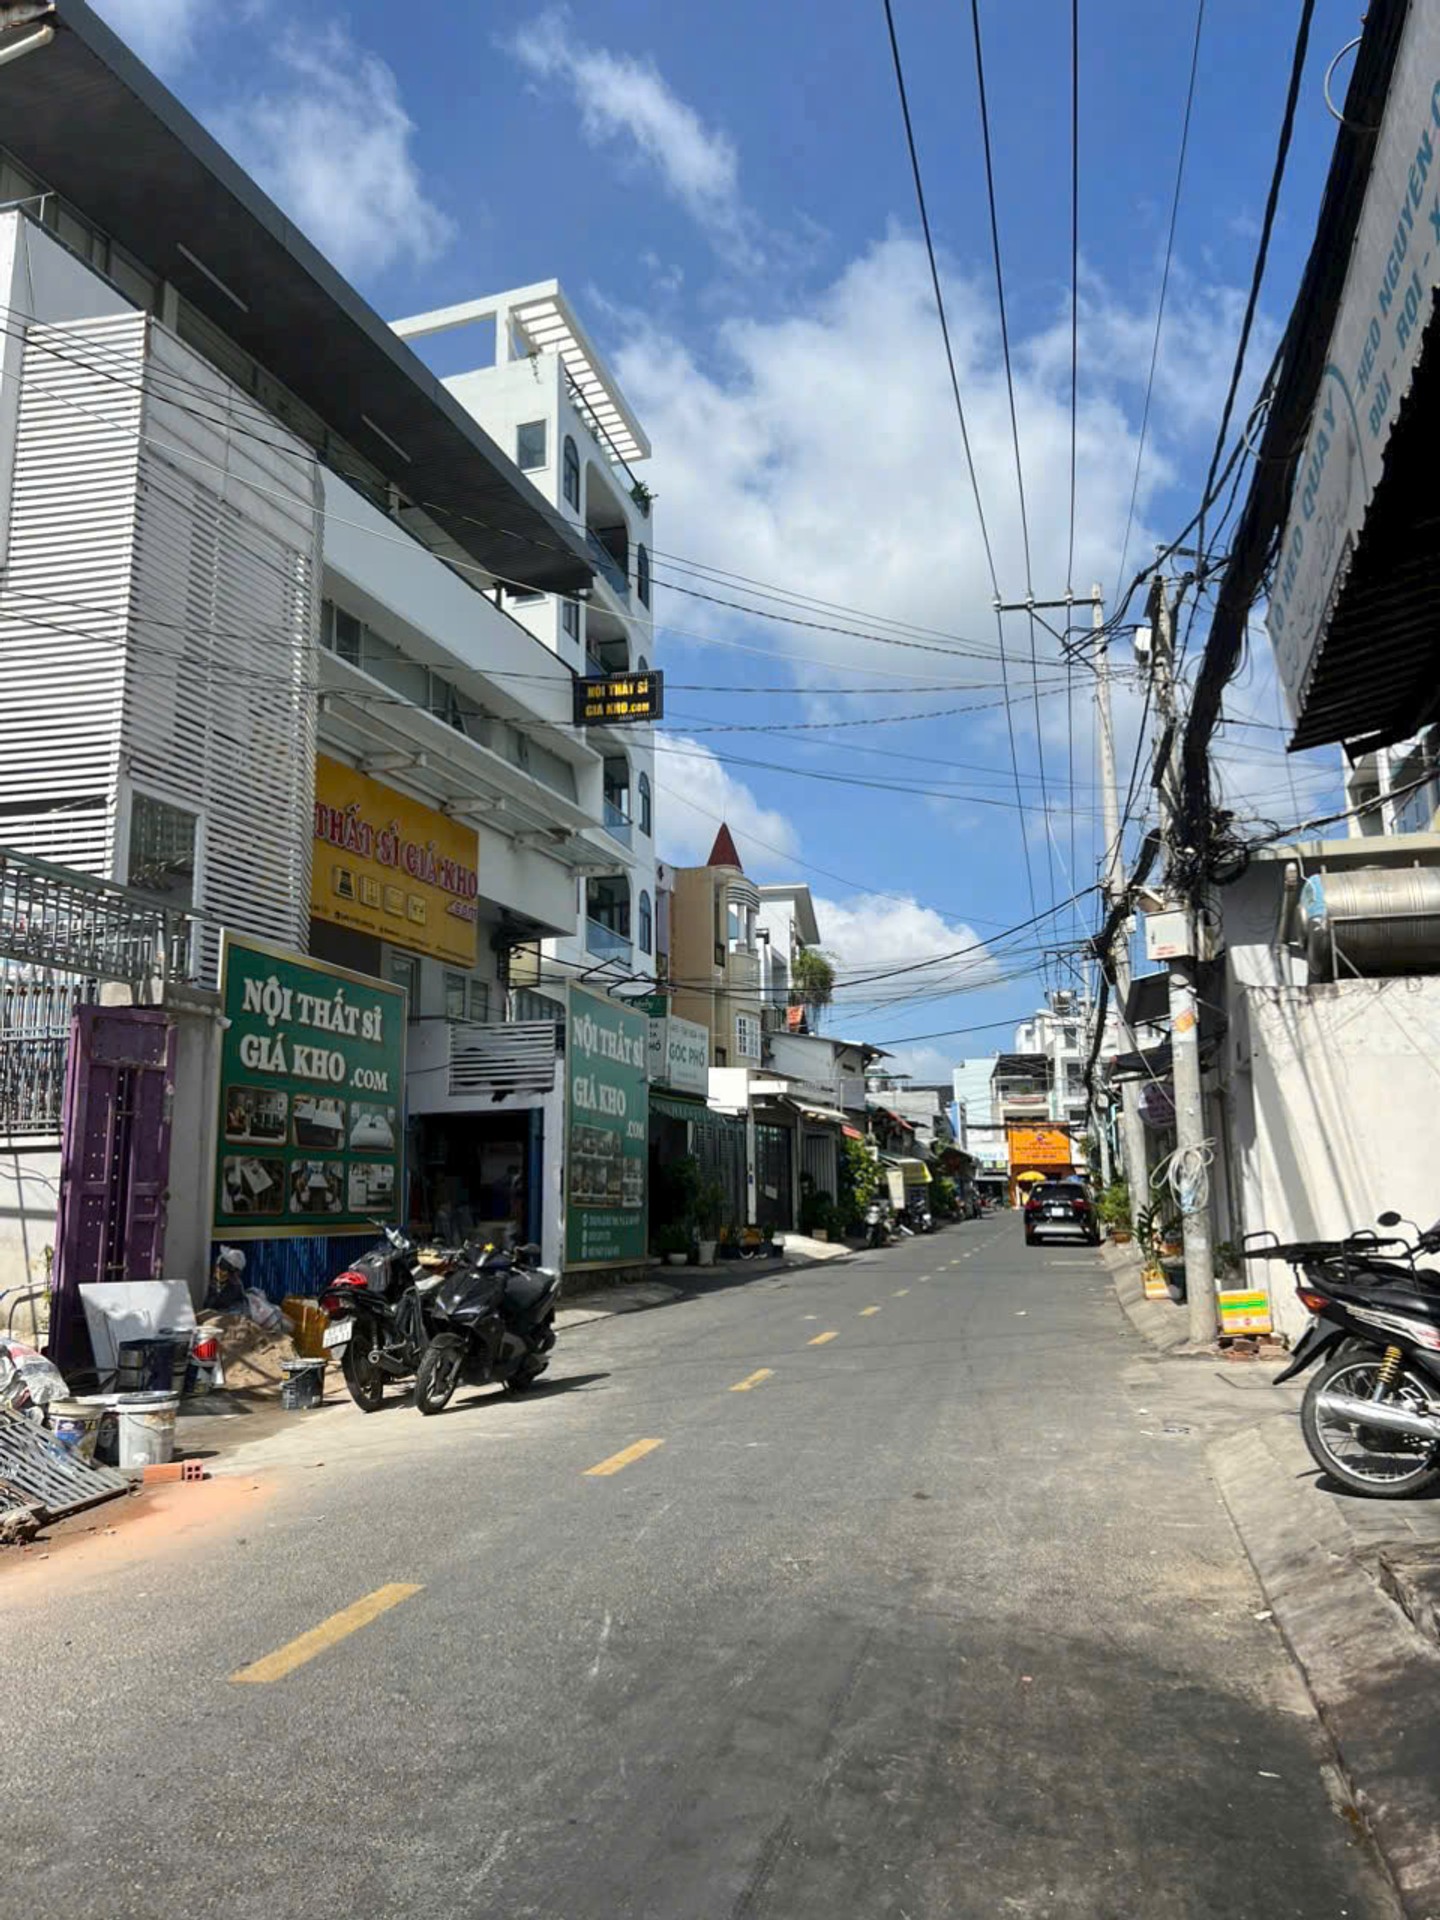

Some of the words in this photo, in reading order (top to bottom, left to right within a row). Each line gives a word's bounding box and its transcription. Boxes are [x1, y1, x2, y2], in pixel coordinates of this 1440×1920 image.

[1357, 317, 1381, 395] HEO
[1378, 130, 1434, 318] NGUYÊN
[1302, 389, 1336, 519] QUAY
[315, 802, 374, 859] THẤT
[403, 840, 437, 884] GIÁ
[439, 859, 478, 900] KHO
[242, 975, 293, 1027] NỘI
[297, 988, 360, 1036] THẤT
[362, 1005, 382, 1042] SỈ
[573, 1013, 598, 1059] NỘI
[599, 1020, 632, 1065] THẤT
[240, 1032, 288, 1073] GIÁ
[292, 1044, 346, 1082] KHO
[350, 1068, 389, 1092] .COM
[573, 1074, 598, 1110] GIÁ
[599, 1083, 627, 1117] KHO
